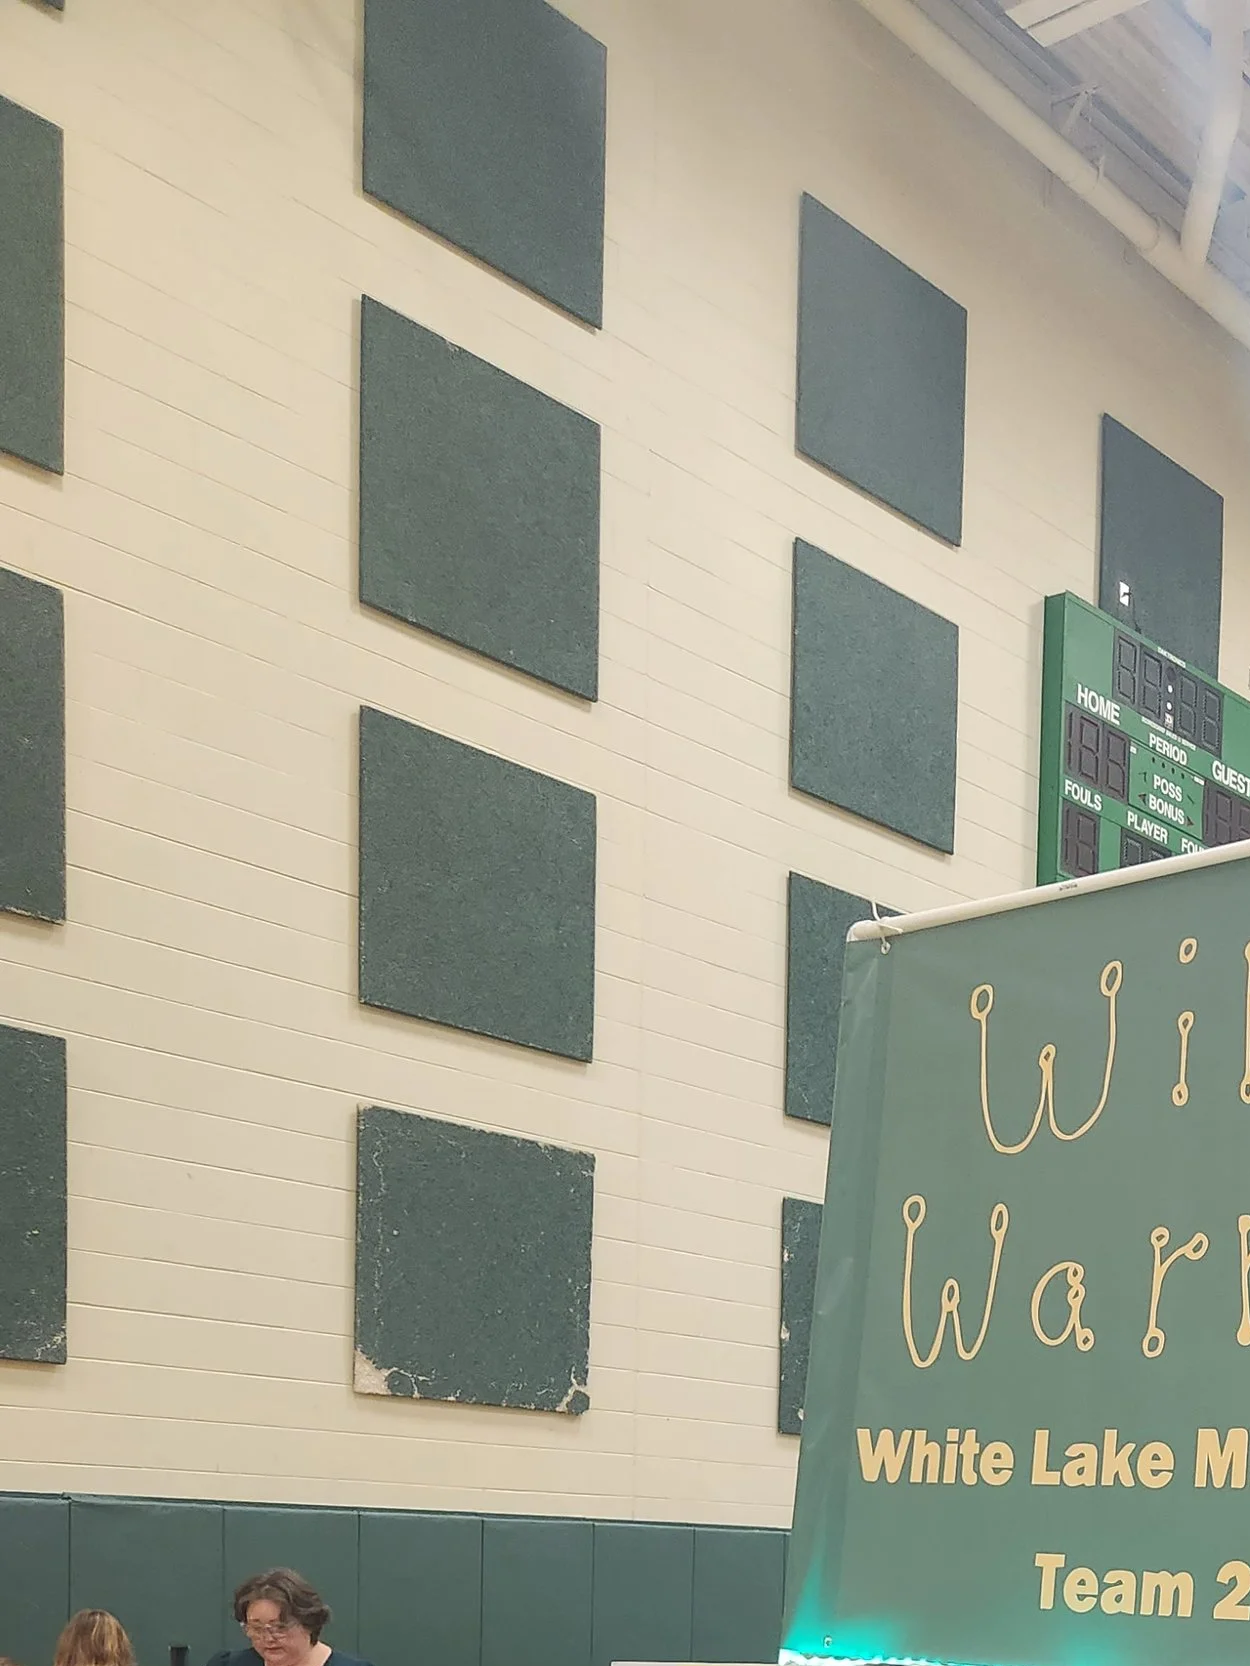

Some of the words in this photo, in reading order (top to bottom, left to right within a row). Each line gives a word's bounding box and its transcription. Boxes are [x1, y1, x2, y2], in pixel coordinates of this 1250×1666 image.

[1076, 683, 1121, 726] HOME
[1149, 733, 1188, 766] PERIOD
[1065, 779, 1102, 811] FOULS
[1153, 774, 1183, 802] POSS
[1149, 794, 1185, 825] BONUS
[1127, 810, 1168, 844] PLAYER
[856, 1427, 1014, 1488] White
[1031, 1428, 1174, 1489] Lake
[1034, 1553, 1195, 1618] Team
